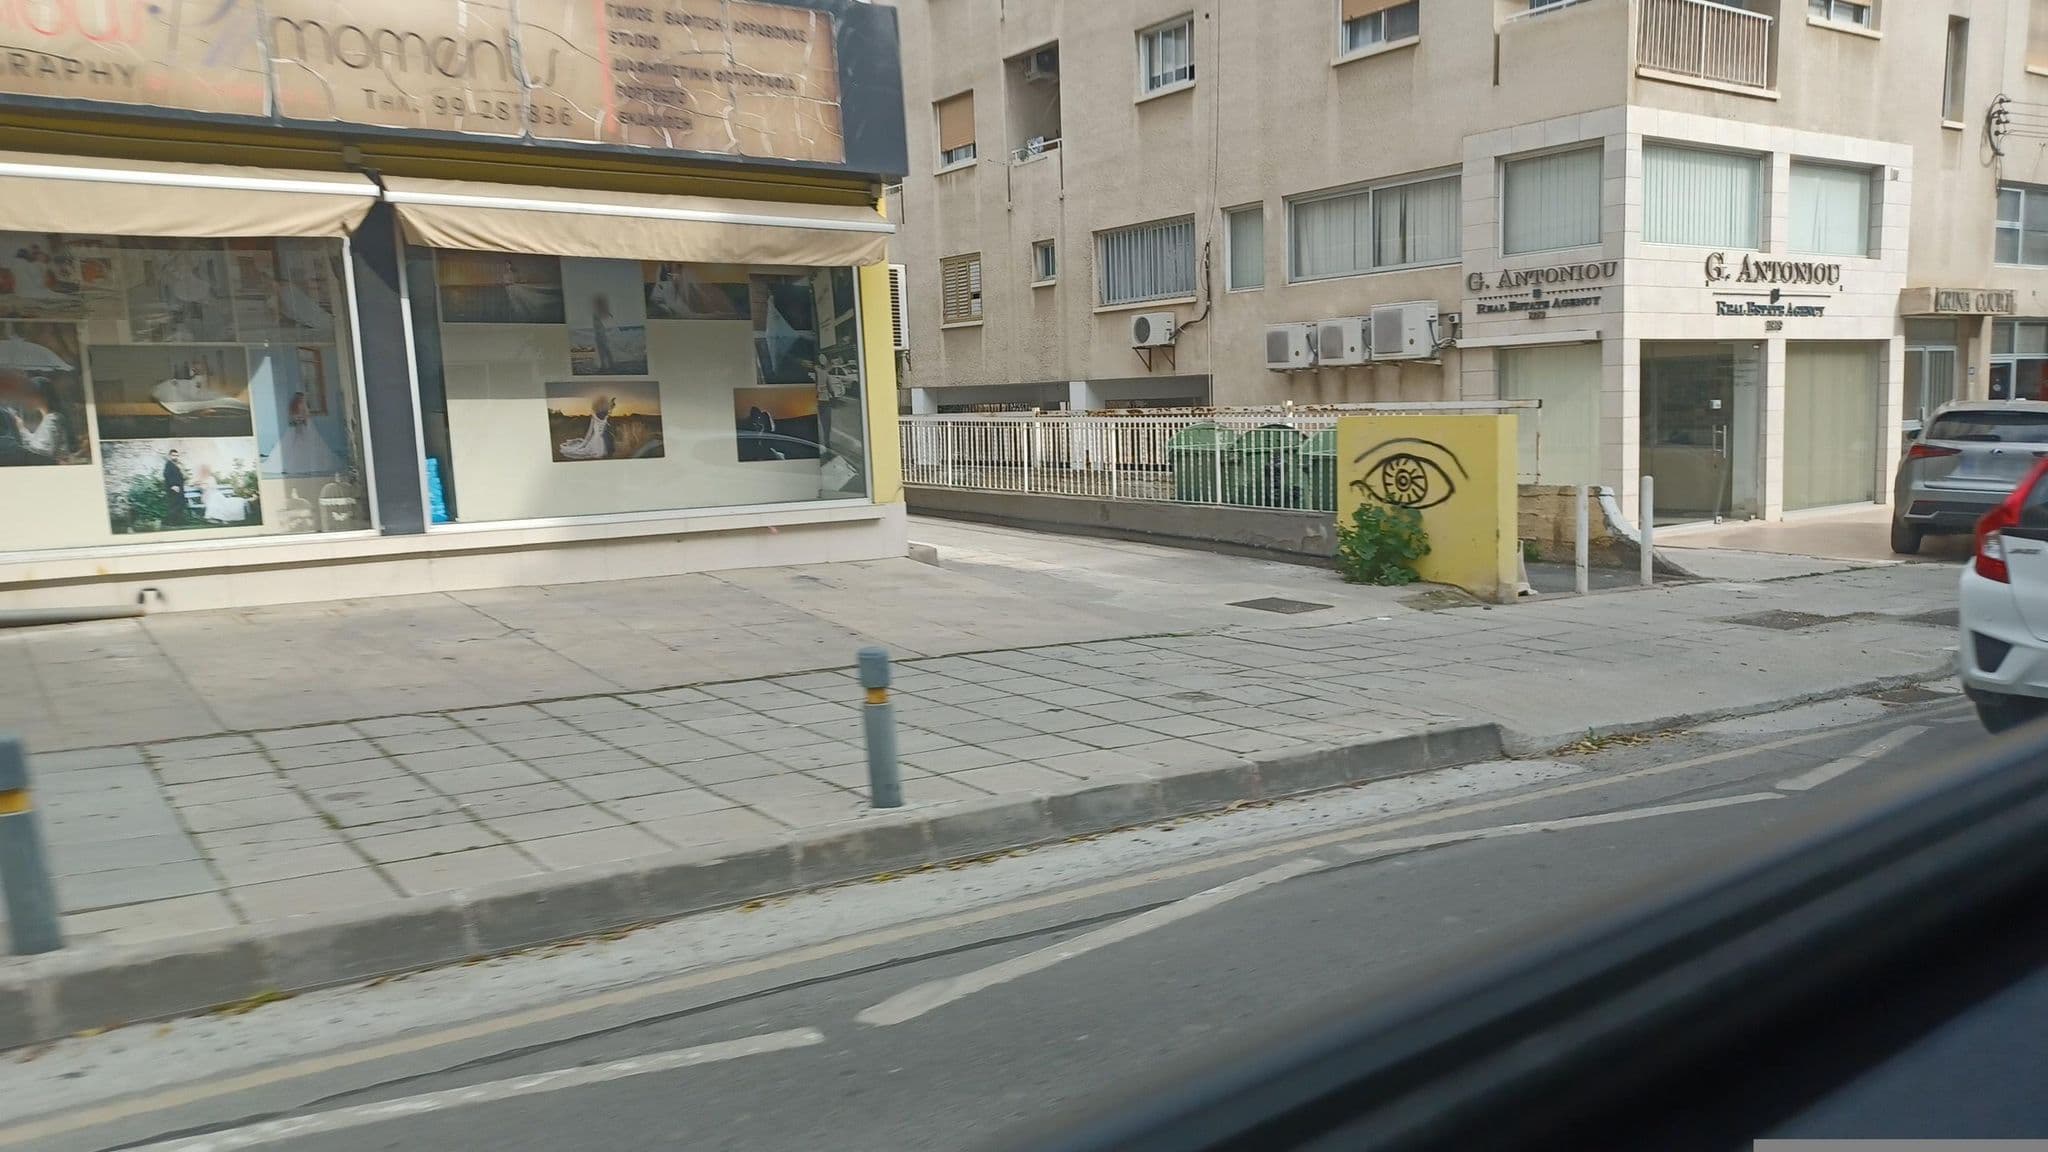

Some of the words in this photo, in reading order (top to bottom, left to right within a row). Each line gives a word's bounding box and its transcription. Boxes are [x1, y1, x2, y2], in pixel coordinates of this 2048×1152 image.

[0, 52, 137, 88] RAPHY
[1467, 271, 1490, 292] G.
[1496, 261, 1618, 289] ANTONIOU
[1705, 252, 1730, 282] G.
[1736, 254, 1841, 286] ANTONIOU
[1476, 303, 1507, 315] REAL
